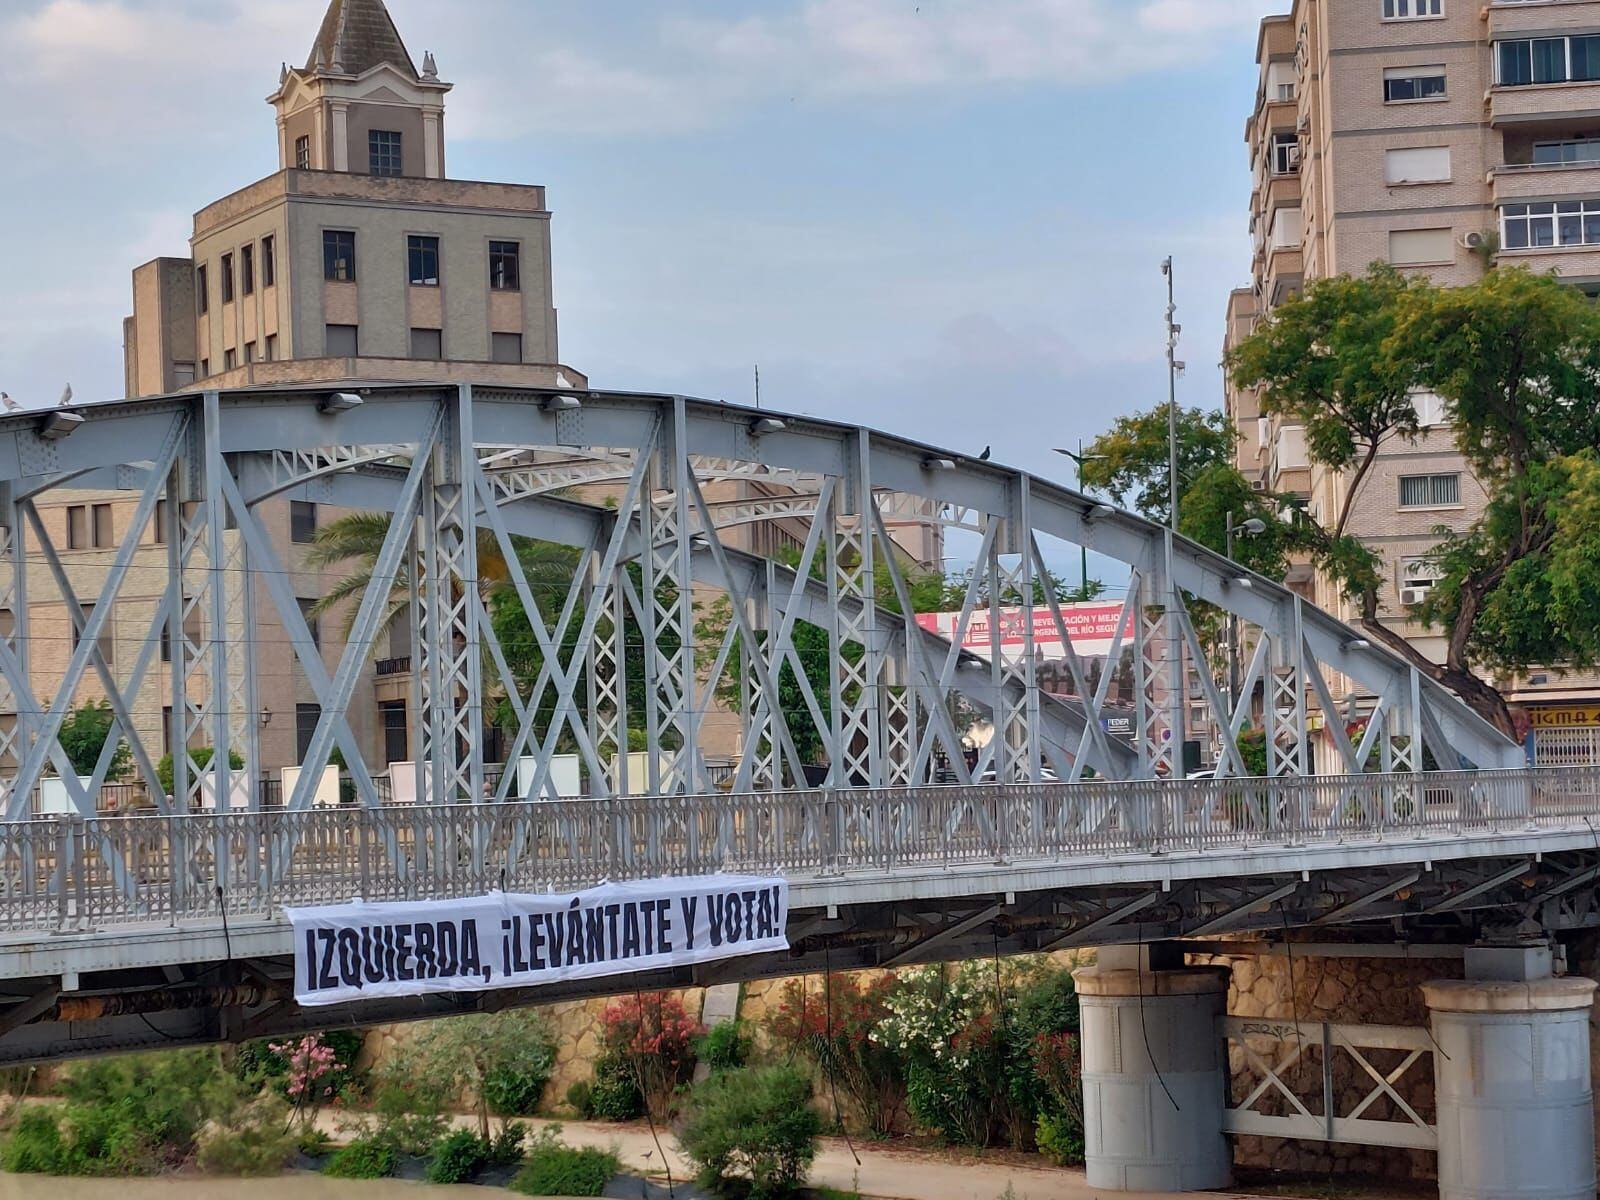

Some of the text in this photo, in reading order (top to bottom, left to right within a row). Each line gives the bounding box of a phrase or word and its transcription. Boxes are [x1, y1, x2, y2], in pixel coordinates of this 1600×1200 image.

[1033, 614, 1090, 626] REVEACIÓN
[1091, 614, 1097, 623] Y
[1097, 613, 1127, 622] MEJO
[306, 885, 780, 990] IZQUIERDA, ¡LEVÁNTATE Y VOTA!
